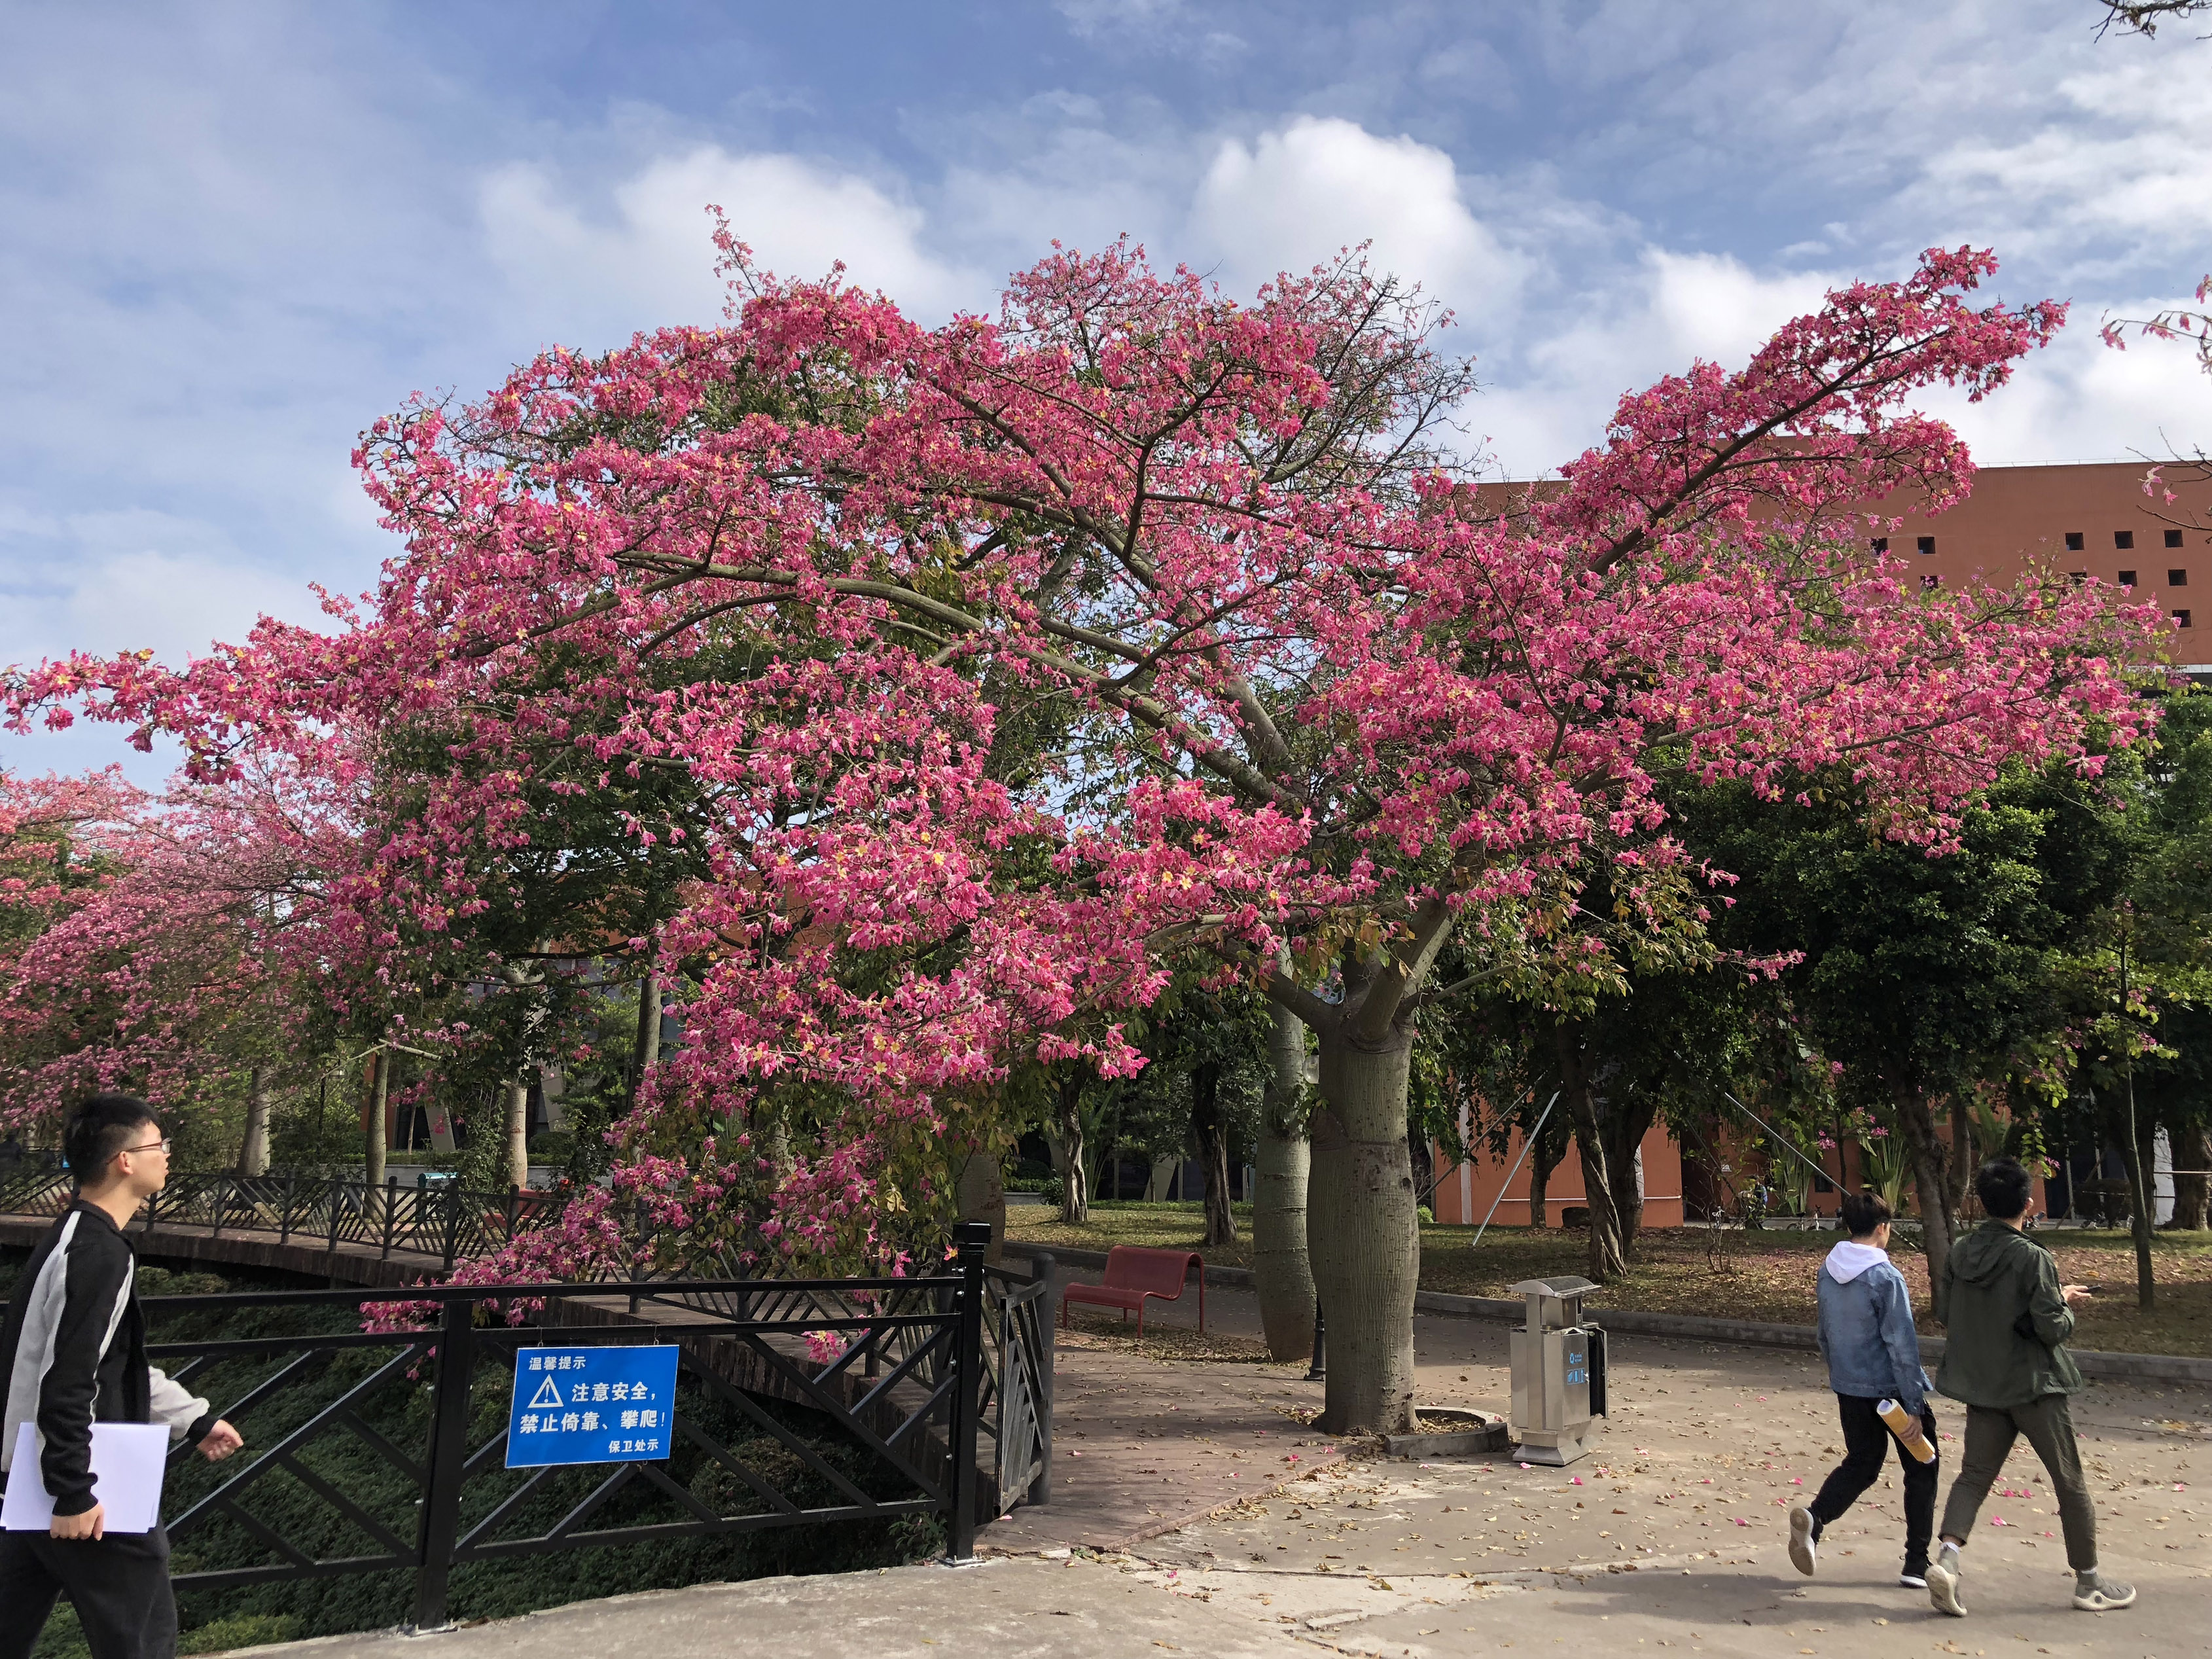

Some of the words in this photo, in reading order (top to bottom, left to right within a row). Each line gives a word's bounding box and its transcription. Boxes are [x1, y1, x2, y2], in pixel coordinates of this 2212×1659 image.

[529, 1356, 586, 1370] 温馨提示
[571, 1382, 656, 1402] 注意安全，
[609, 1438, 659, 1454] 保卫处示
